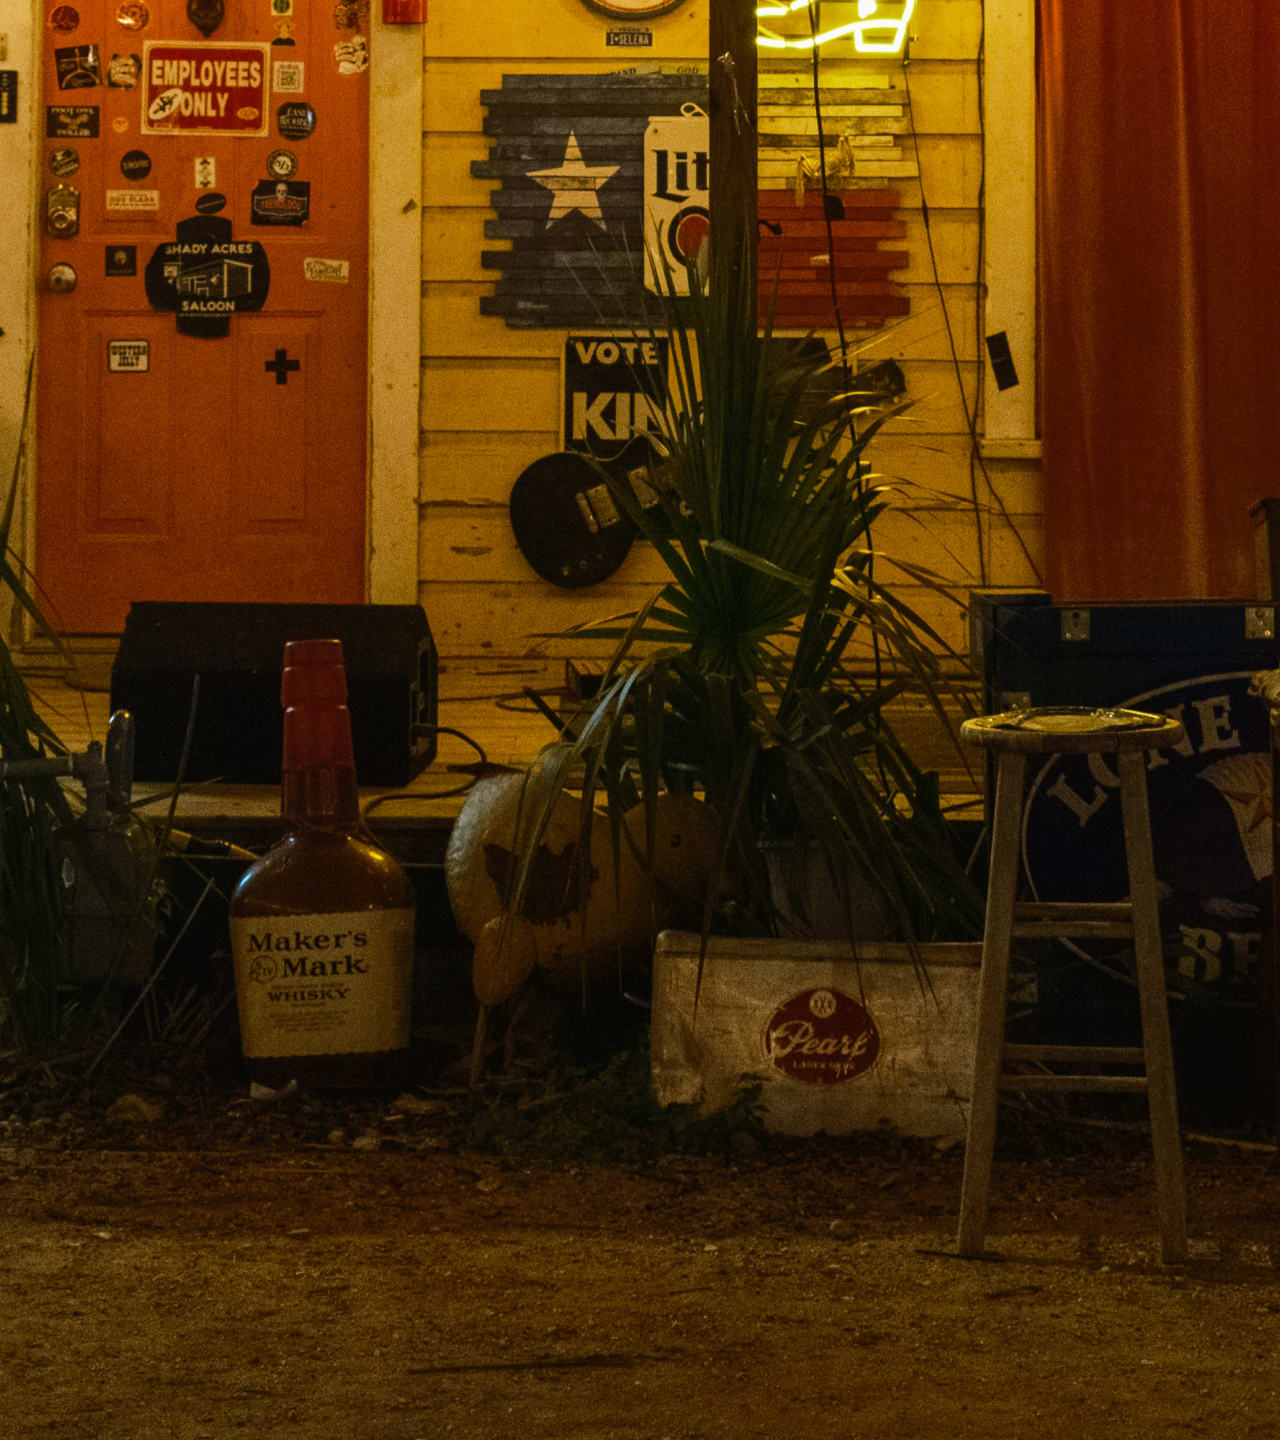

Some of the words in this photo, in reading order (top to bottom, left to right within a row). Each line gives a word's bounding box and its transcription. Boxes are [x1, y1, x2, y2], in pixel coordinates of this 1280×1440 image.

[151, 59, 262, 88] EMPLOYEES
[180, 91, 229, 117] ONLY
[651, 148, 710, 203] Lit
[165, 244, 208, 255] SHADY
[211, 243, 254, 255] ACRES
[181, 300, 236, 312] SALOON
[575, 341, 660, 366] VOTE
[248, 930, 369, 954] Maker's
[281, 954, 370, 979] Mark
[267, 988, 352, 1003] WHISKY
[769, 1019, 869, 1059] Pearl
